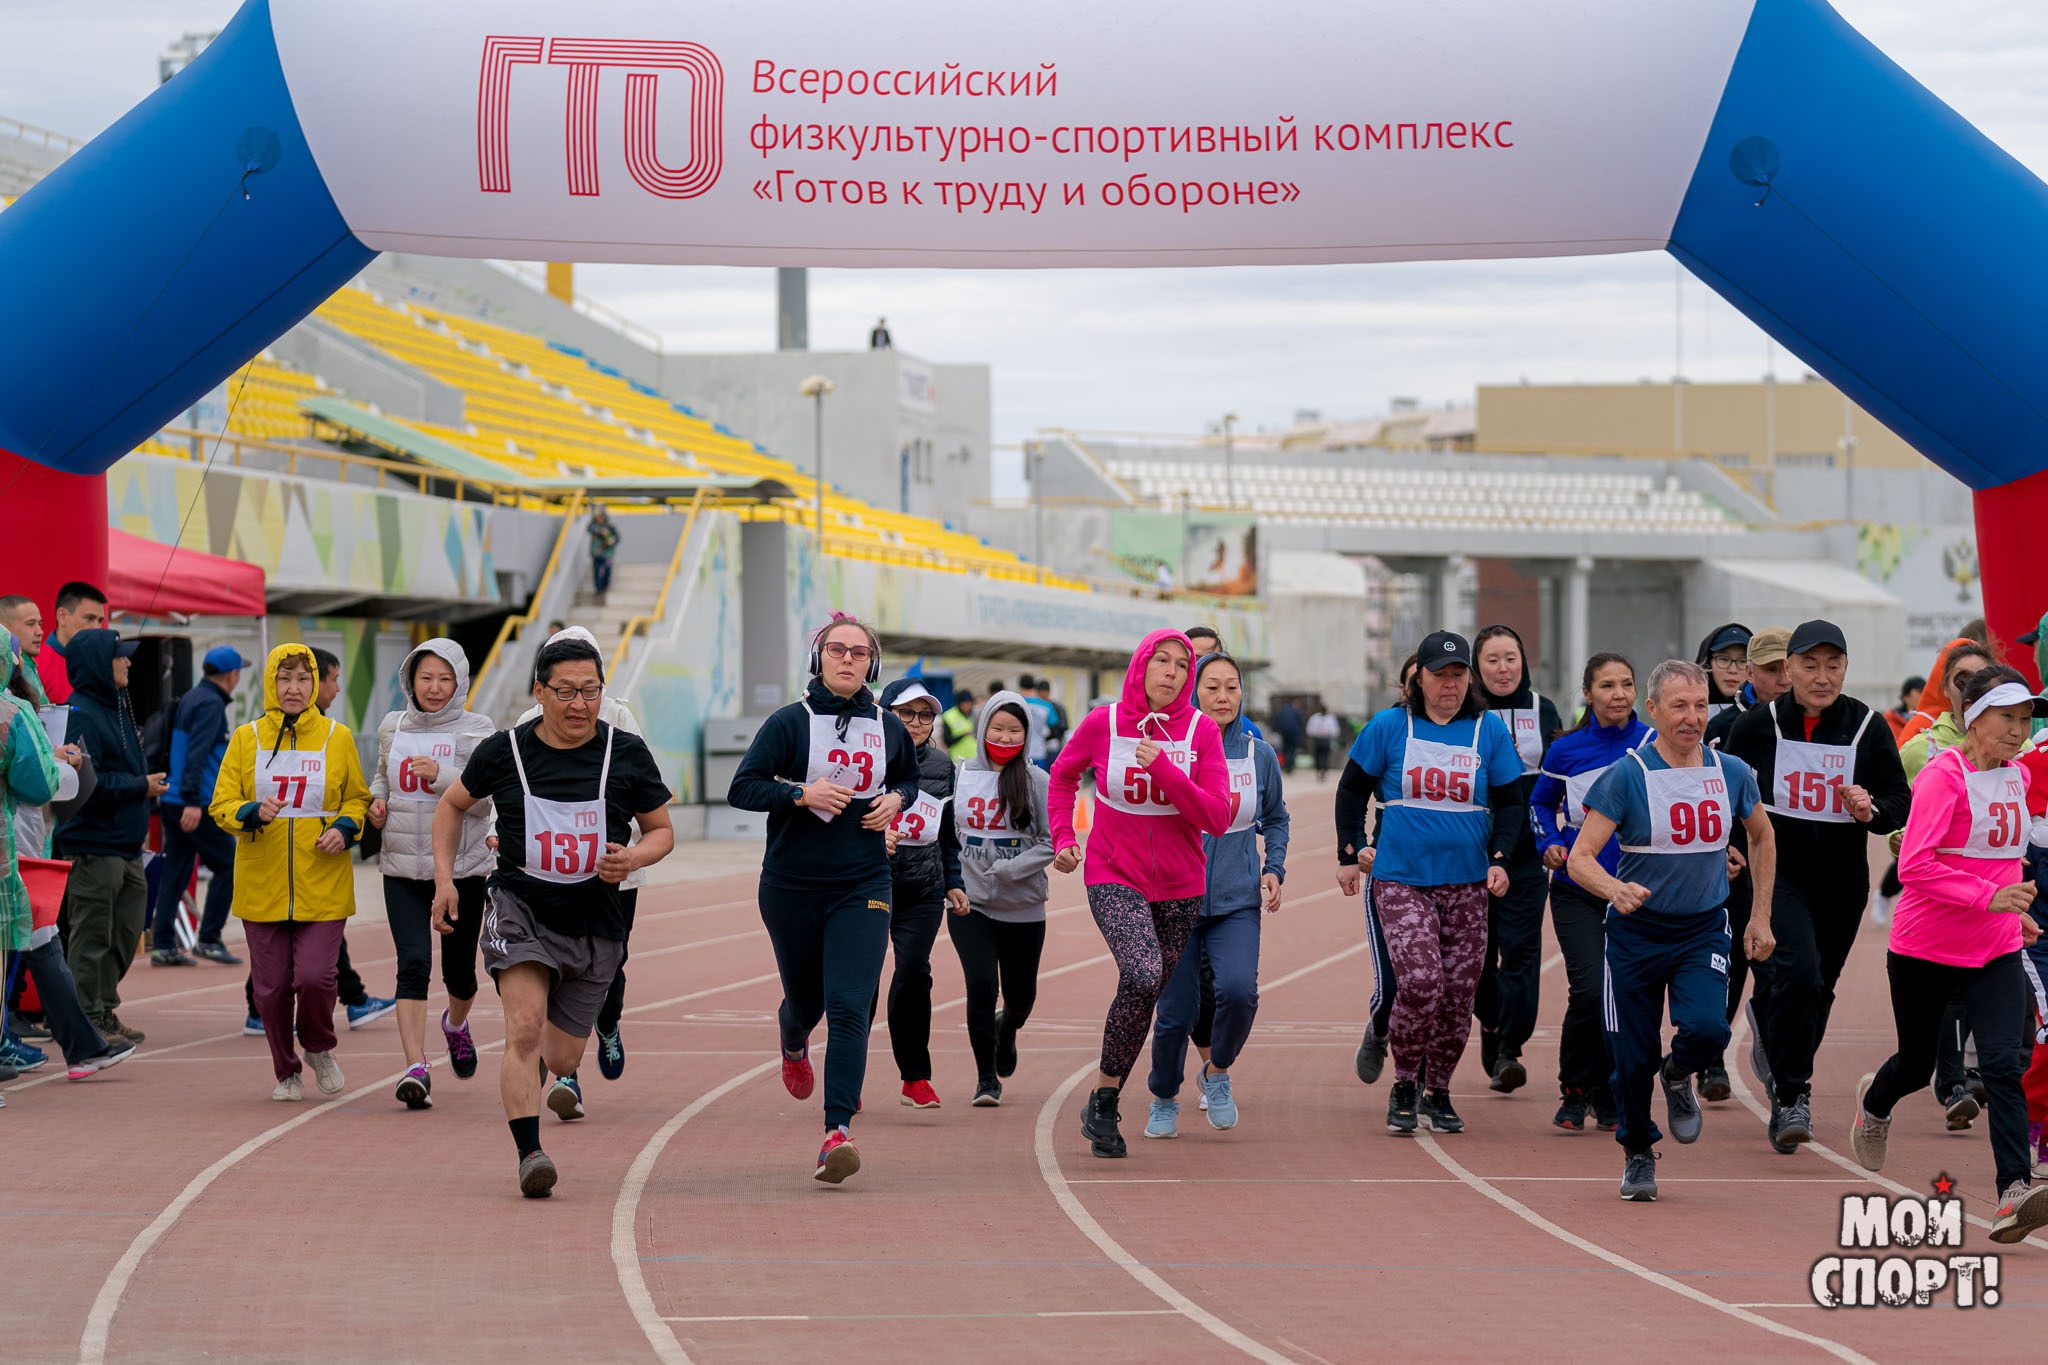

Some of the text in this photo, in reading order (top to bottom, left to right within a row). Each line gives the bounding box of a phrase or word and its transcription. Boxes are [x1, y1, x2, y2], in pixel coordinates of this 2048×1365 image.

[753, 60, 1056, 98] Всероссийский
[478, 35, 724, 200] ГТО
[750, 113, 1512, 162] физкультурно-спортивный комплекс
[753, 173, 1300, 214] «Готов к труду и обороне»
[1516, 718, 1535, 730] ГТО
[431, 744, 451, 757] ГТО
[864, 733, 882, 749] ГТО
[301, 759, 321, 773] ГТО
[1452, 754, 1472, 767] ГТО
[1822, 754, 1846, 768] ГТО
[272, 776, 307, 808] 77
[1234, 773, 1252, 788] ГТО
[1407, 766, 1469, 803] 195
[1703, 778, 1724, 795] ГТО
[1784, 771, 1845, 814] 151
[575, 811, 598, 828] ГТО
[920, 801, 938, 818] ГТО
[967, 797, 1007, 830] 32
[1670, 800, 1722, 845] 96
[1988, 802, 2022, 848] 37
[535, 830, 598, 874] 137
